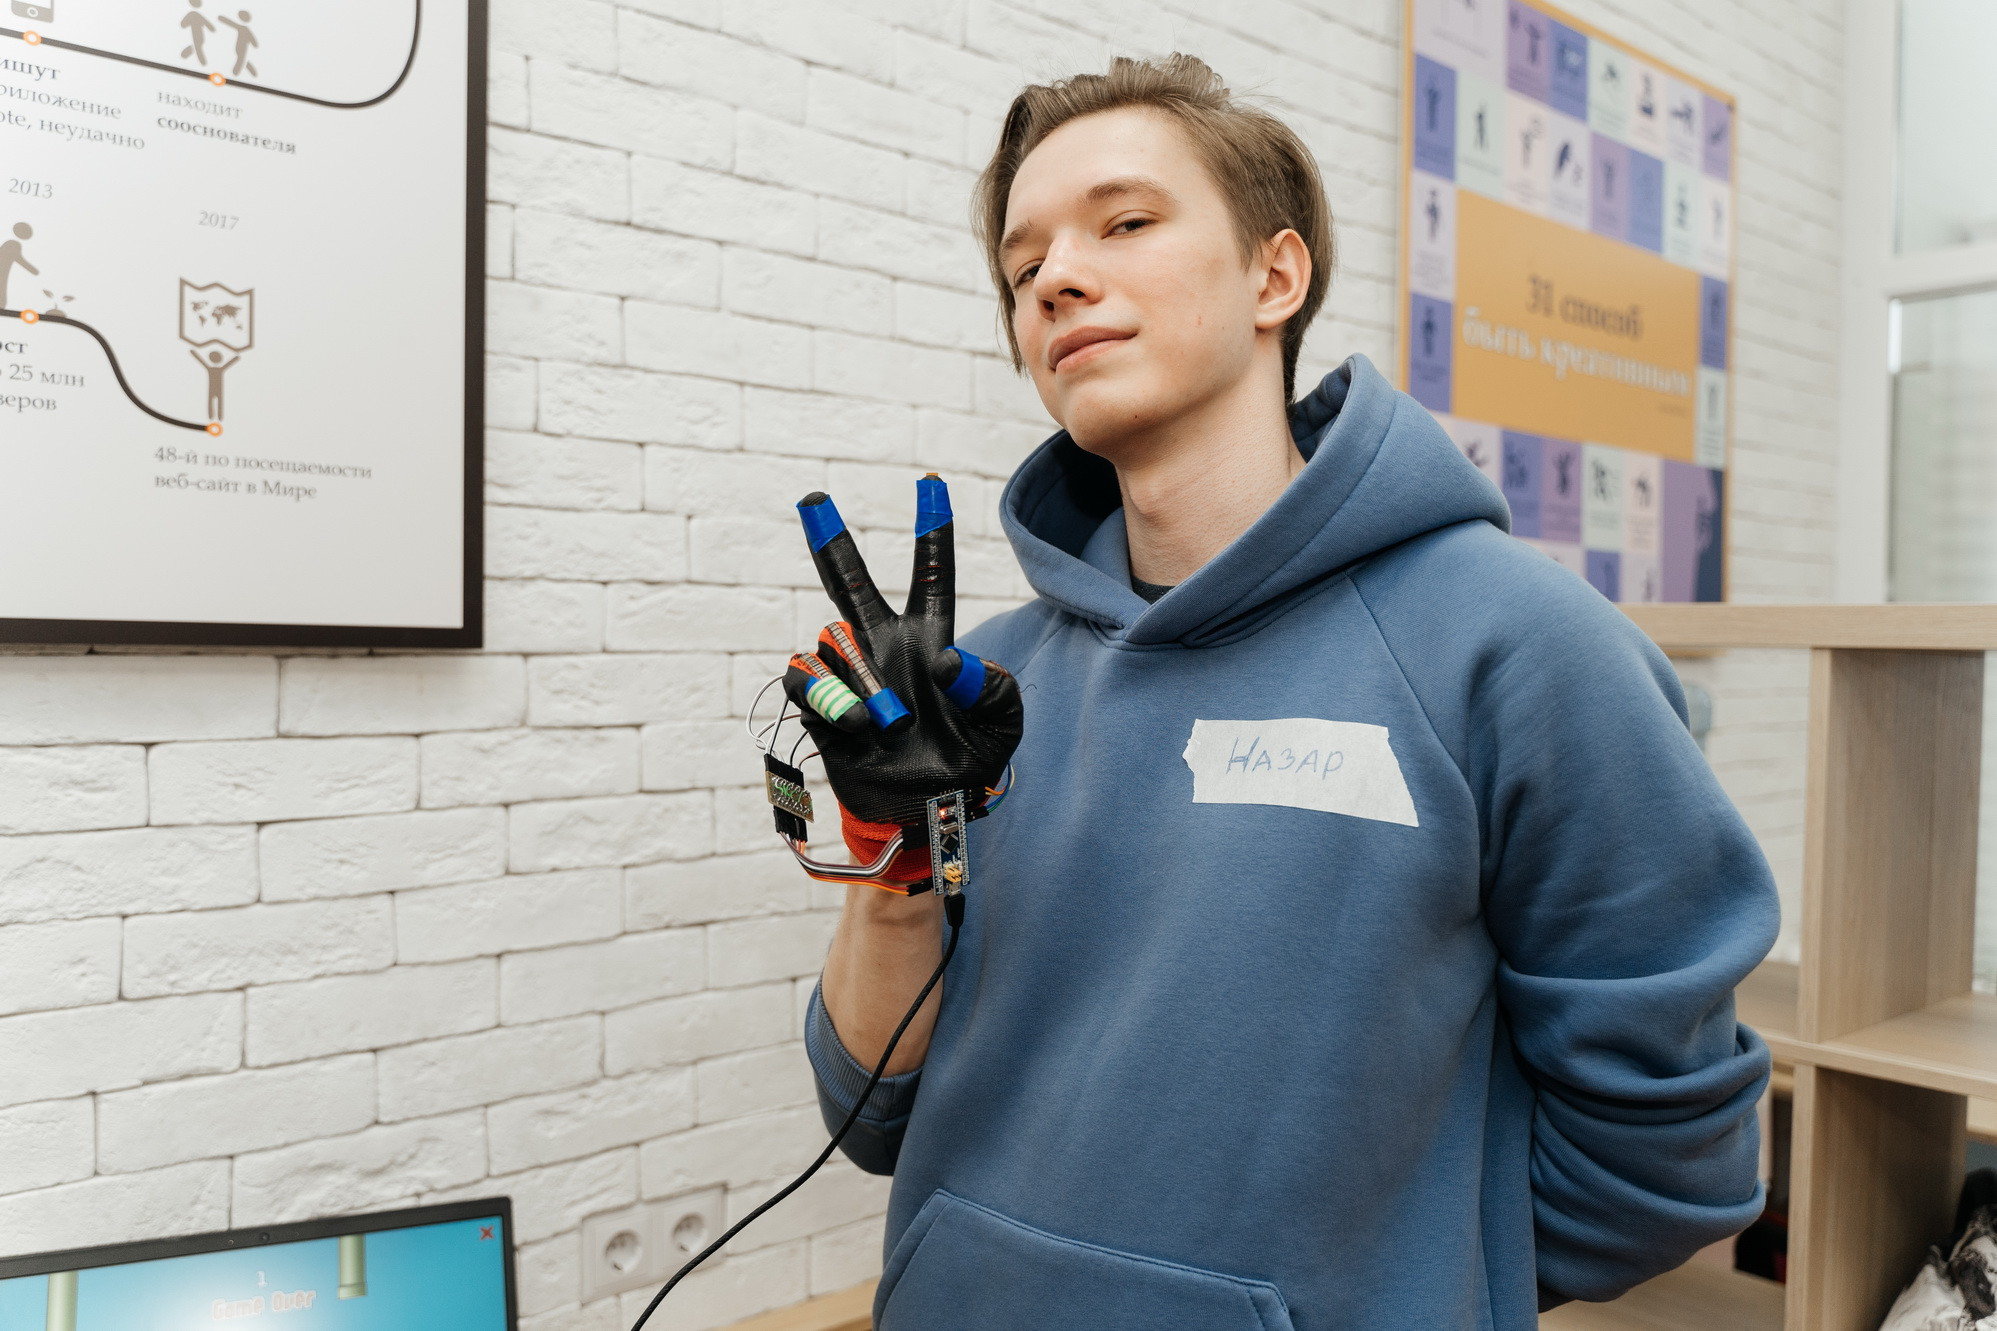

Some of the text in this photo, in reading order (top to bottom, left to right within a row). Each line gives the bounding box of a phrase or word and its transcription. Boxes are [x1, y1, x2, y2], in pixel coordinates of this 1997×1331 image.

[157, 91, 243, 119] находит
[40, 119, 145, 149] неудачно
[157, 116, 297, 154] сооснователя
[9, 178, 53, 199] 2013
[199, 210, 239, 230] 2017
[0, 340, 28, 354] ст
[9, 363, 33, 381] 25
[40, 371, 84, 387] млн
[155, 446, 372, 480] 48-й по посещаемости
[155, 473, 318, 502] веб-сайт в Мире
[212, 1290, 317, 1320] Game Over
